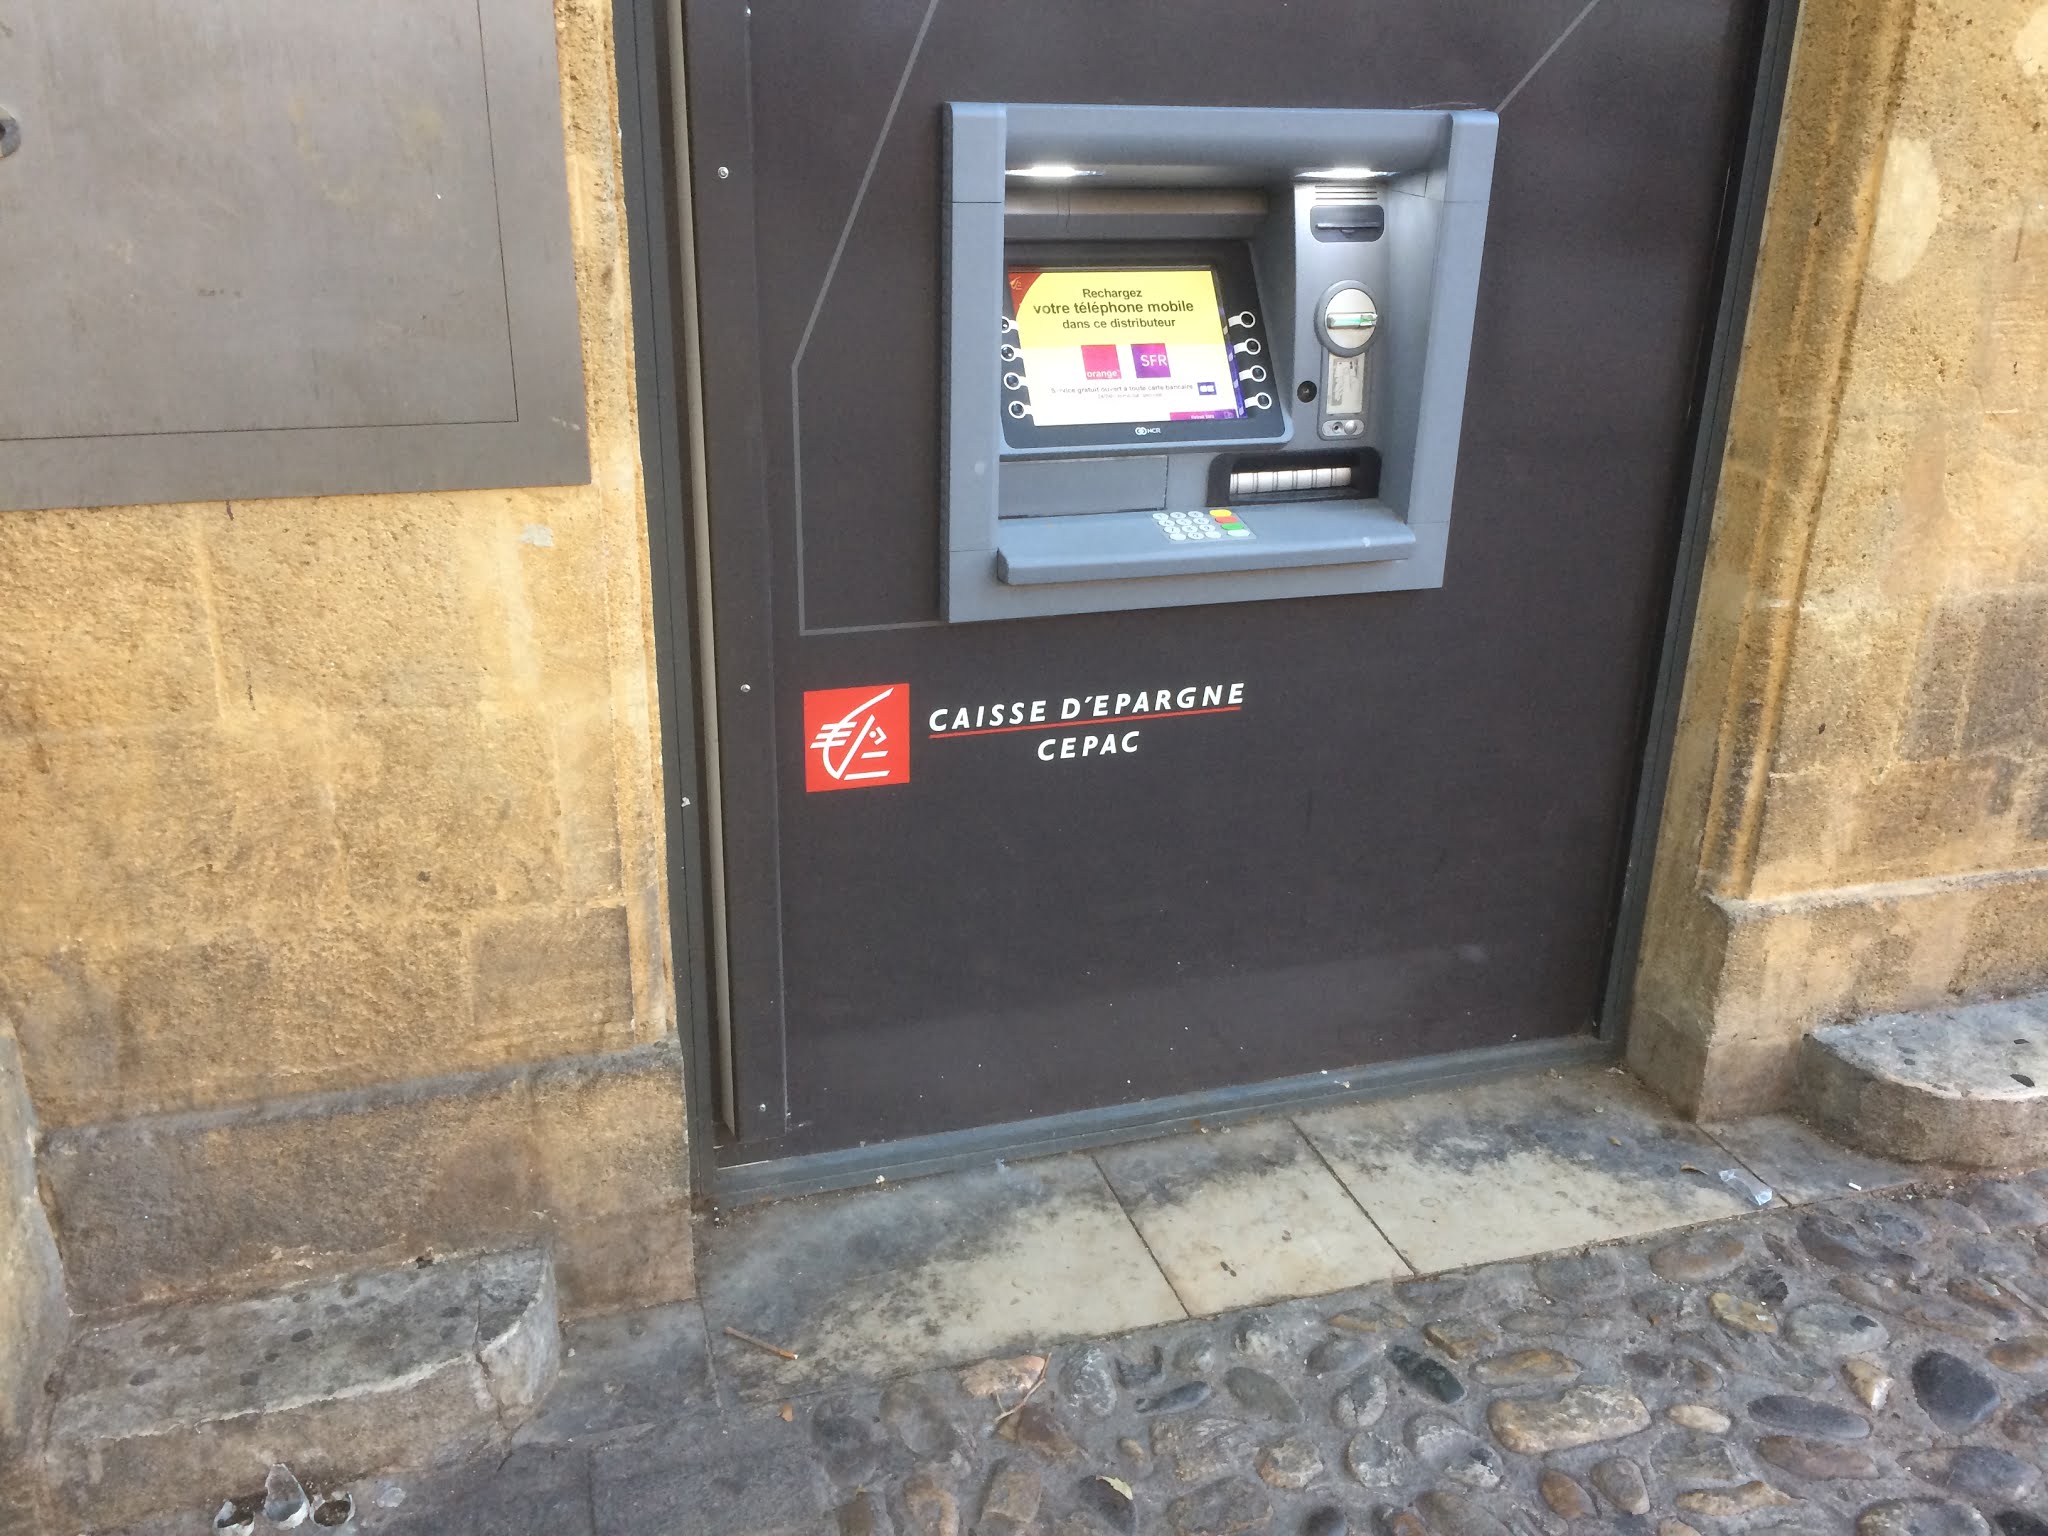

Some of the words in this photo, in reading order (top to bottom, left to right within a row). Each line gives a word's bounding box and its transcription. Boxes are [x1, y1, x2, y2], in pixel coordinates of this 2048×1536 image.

[1082, 288, 1142, 300] Rechargez
[1033, 303, 1070, 315] votre
[1074, 301, 1144, 316] téléphone
[1147, 300, 1194, 313] mobile
[1062, 319, 1090, 329] dans
[1093, 319, 1107, 329] ce
[1110, 318, 1176, 328] distributeur
[1140, 354, 1168, 367] SFR
[1086, 370, 1118, 378] orange
[928, 700, 1047, 732] CAISSE
[1060, 683, 1246, 720] D'EPARGNE
[1037, 731, 1140, 761] CEPAC
